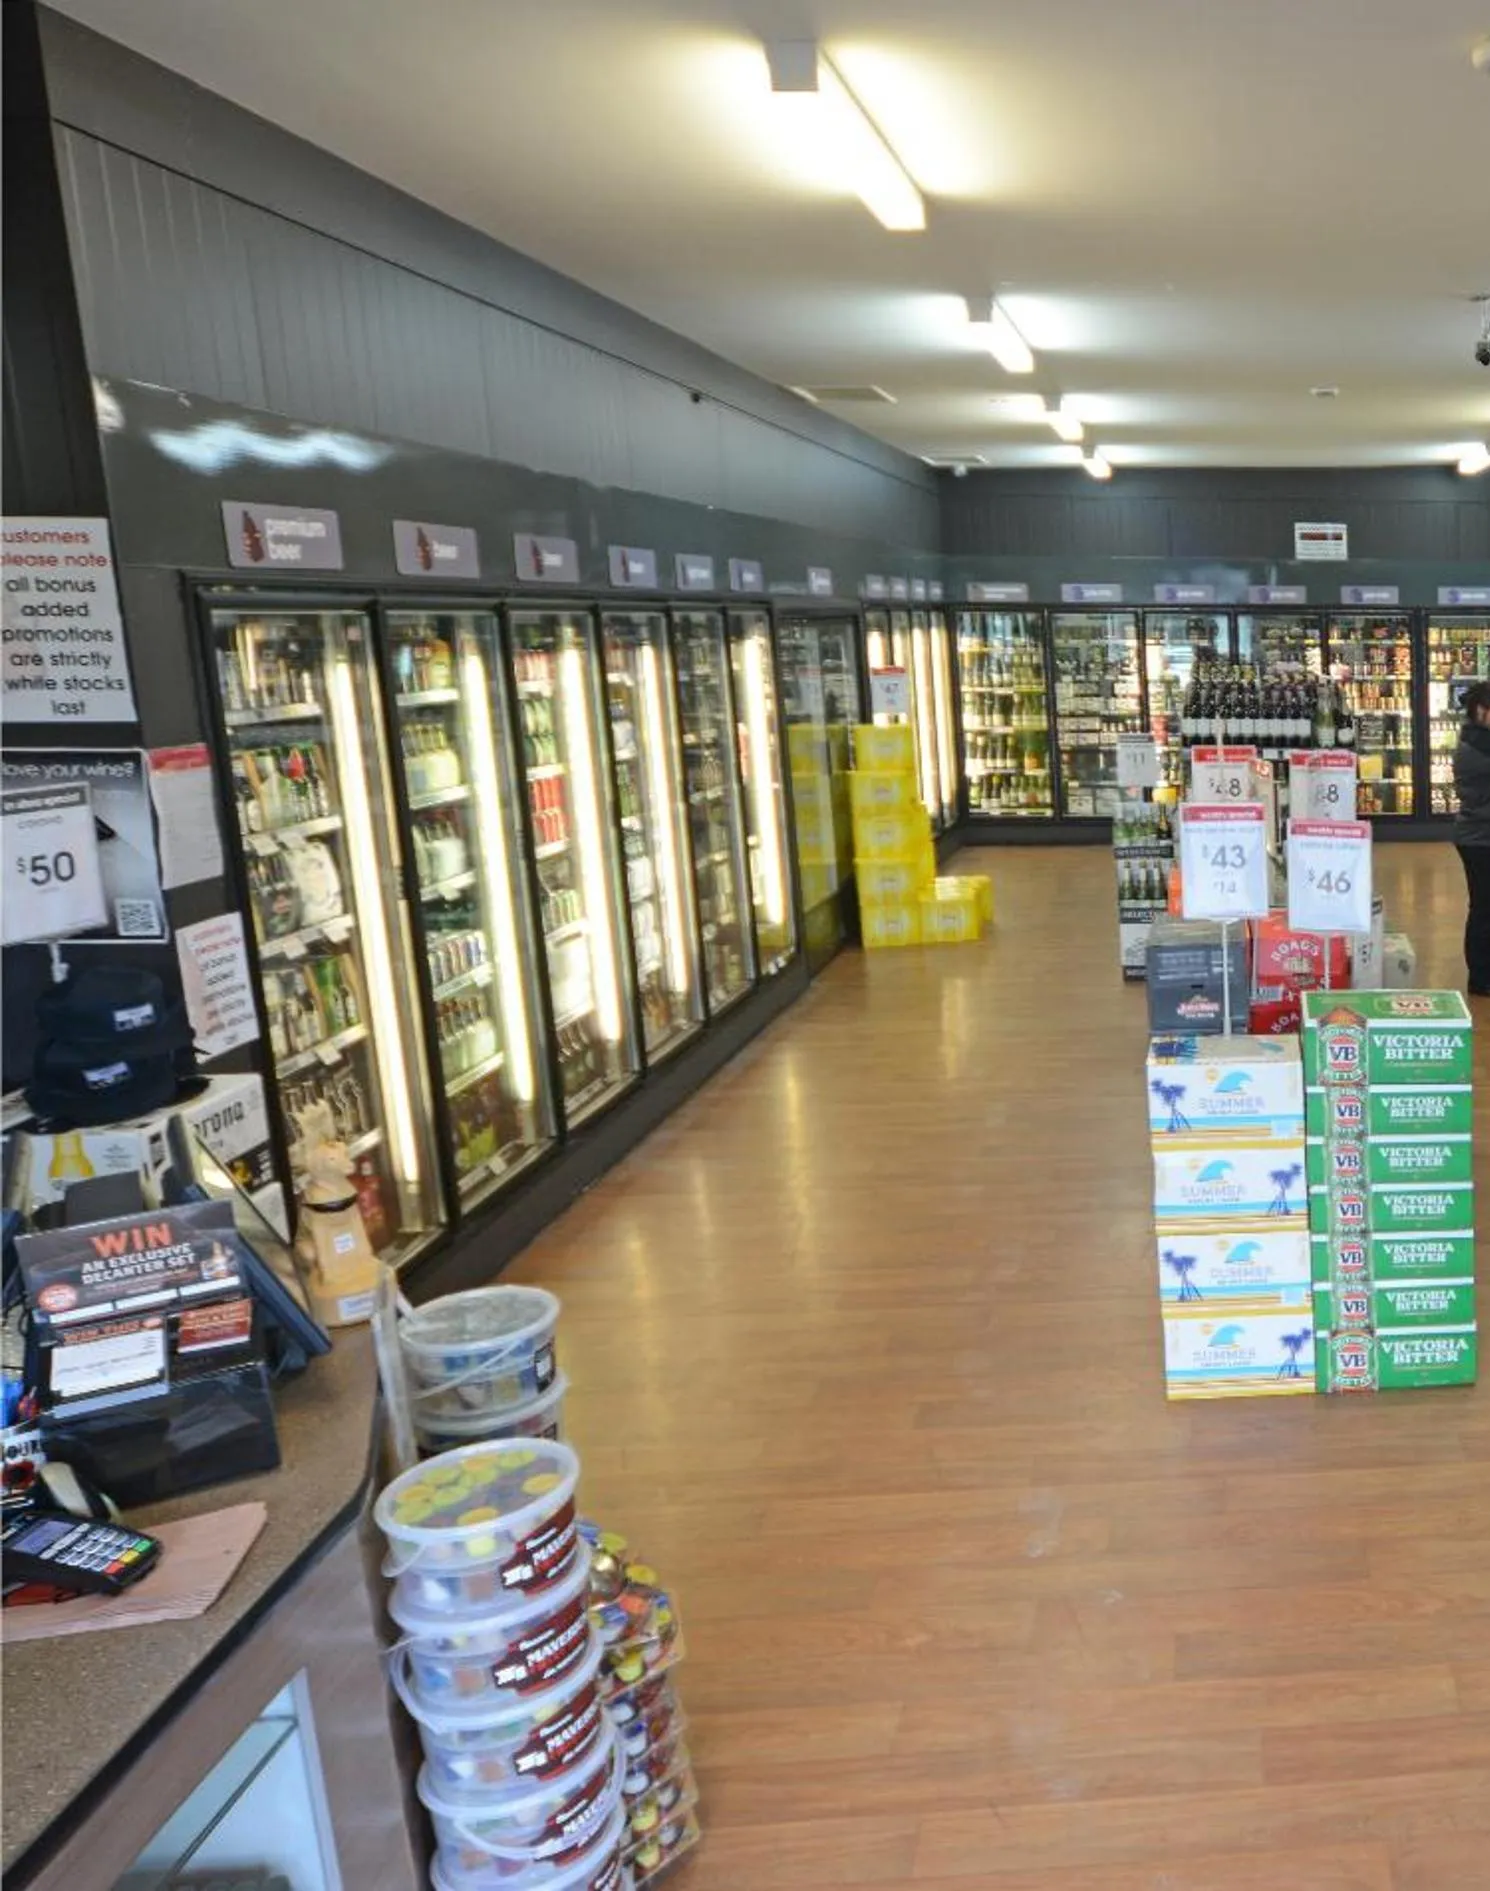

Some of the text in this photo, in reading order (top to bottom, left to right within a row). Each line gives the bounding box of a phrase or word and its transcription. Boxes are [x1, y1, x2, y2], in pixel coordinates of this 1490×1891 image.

[1, 530, 90, 543] ustomers
[269, 543, 301, 559] beer
[5, 577, 96, 593] all bonus
[21, 602, 89, 617] added
[2, 628, 114, 643] promotions
[10, 651, 112, 669] are strictly
[5, 676, 125, 690] while stocks
[52, 701, 86, 715] last
[43, 764, 84, 779] your
[84, 761, 135, 778] wine?
[1203, 844, 1247, 869] $43
[17, 851, 75, 886] $50
[1308, 867, 1351, 894] $46
[1373, 1034, 1464, 1048] VICTORIA
[1329, 1046, 1356, 1060] VB
[1384, 1047, 1454, 1060] BITTER
[1381, 1095, 1453, 1108] VICTORIA
[1337, 1105, 1359, 1118] VB
[1390, 1107, 1445, 1118] BITTER
[194, 1101, 245, 1138] orona
[1379, 1145, 1452, 1158] VICTORIA
[1335, 1155, 1358, 1168] VB
[1389, 1156, 1444, 1168] BITTER
[1382, 1195, 1454, 1207] VICTORIA
[1340, 1203, 1362, 1217] VB
[1391, 1205, 1446, 1215] BITTER
[90, 1222, 173, 1258] WIN
[1383, 1241, 1455, 1254] VICTORIA
[82, 1242, 191, 1274] AN EXCLUSIVE
[1341, 1252, 1362, 1265] VB
[1391, 1252, 1447, 1263] BITTER
[82, 1252, 196, 1285] DECANTER SET
[1386, 1289, 1456, 1302] VICTORIA
[1344, 1300, 1365, 1314] VB
[1396, 1300, 1449, 1312] BITTER
[1382, 1339, 1468, 1353] VICTORIA
[1340, 1354, 1366, 1367] VB
[1393, 1352, 1459, 1364] BITTER
